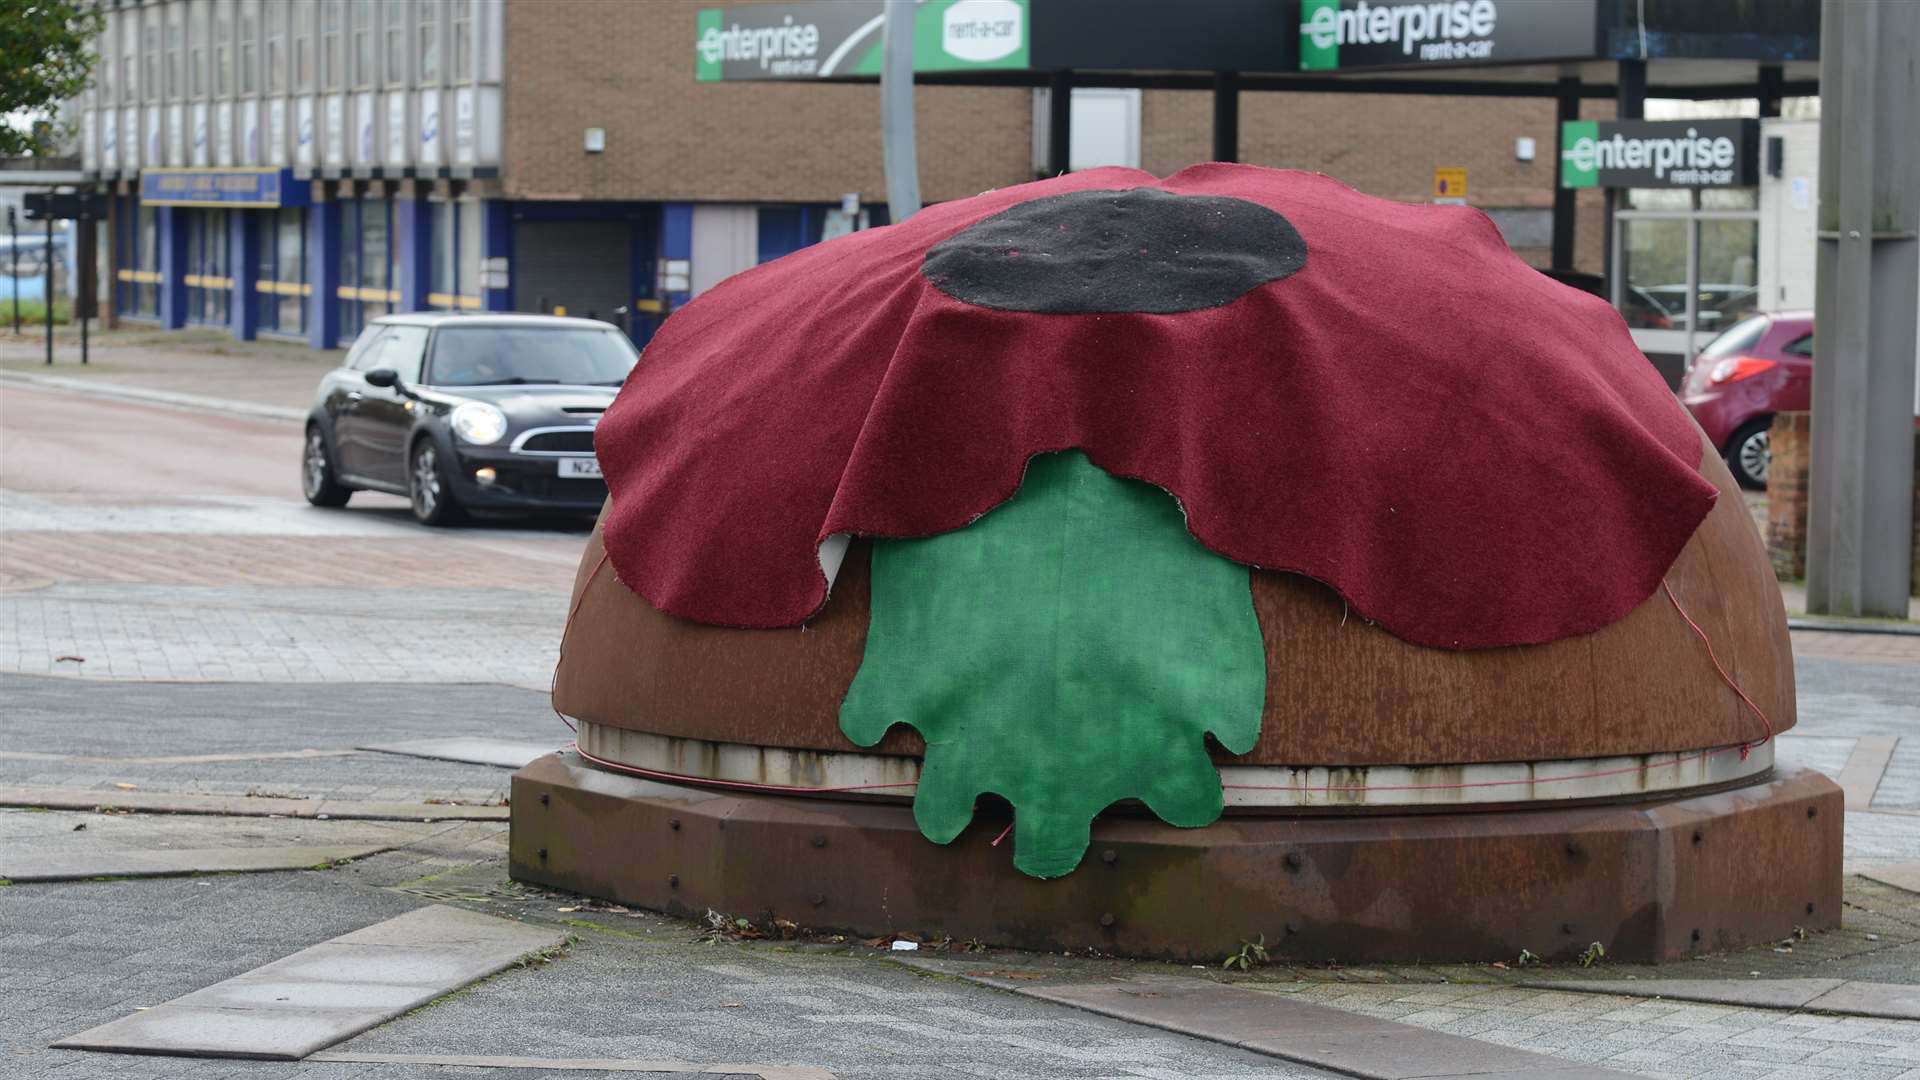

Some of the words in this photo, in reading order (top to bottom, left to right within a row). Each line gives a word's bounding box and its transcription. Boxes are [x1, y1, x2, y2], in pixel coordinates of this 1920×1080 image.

[700, 15, 819, 69] enterprise
[949, 20, 1014, 38] rent-a-car
[1302, 0, 1497, 55] enterprise
[1419, 40, 1495, 60] rent-a-car
[1565, 127, 1735, 179] enterprise
[1669, 170, 1734, 184] rent-a-car
